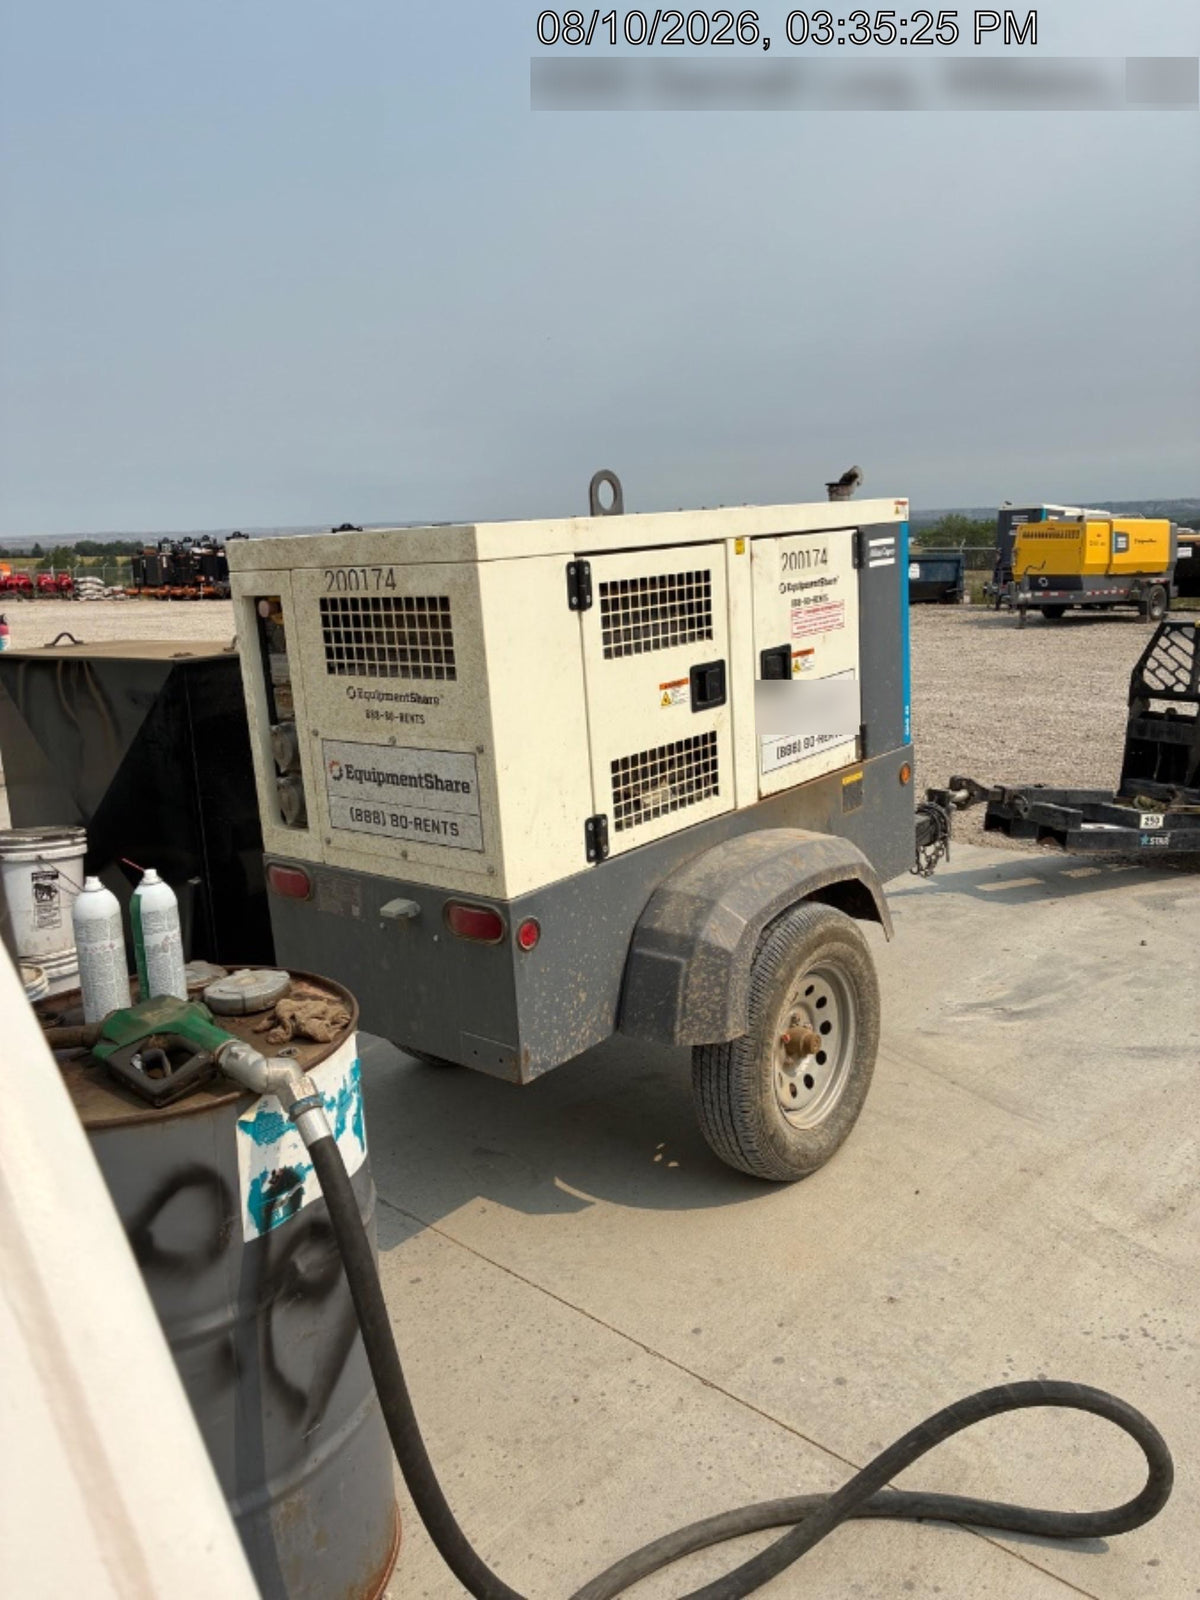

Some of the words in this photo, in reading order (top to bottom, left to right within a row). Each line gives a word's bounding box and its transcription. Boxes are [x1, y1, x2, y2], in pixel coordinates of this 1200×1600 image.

[781, 547, 828, 571] 200174
[324, 567, 398, 593] 200174
[356, 687, 440, 706] EquipmentShare
[343, 763, 471, 795] EquipmentShare
[349, 806, 387, 828] (888)
[389, 813, 460, 838] 80-RENTS
